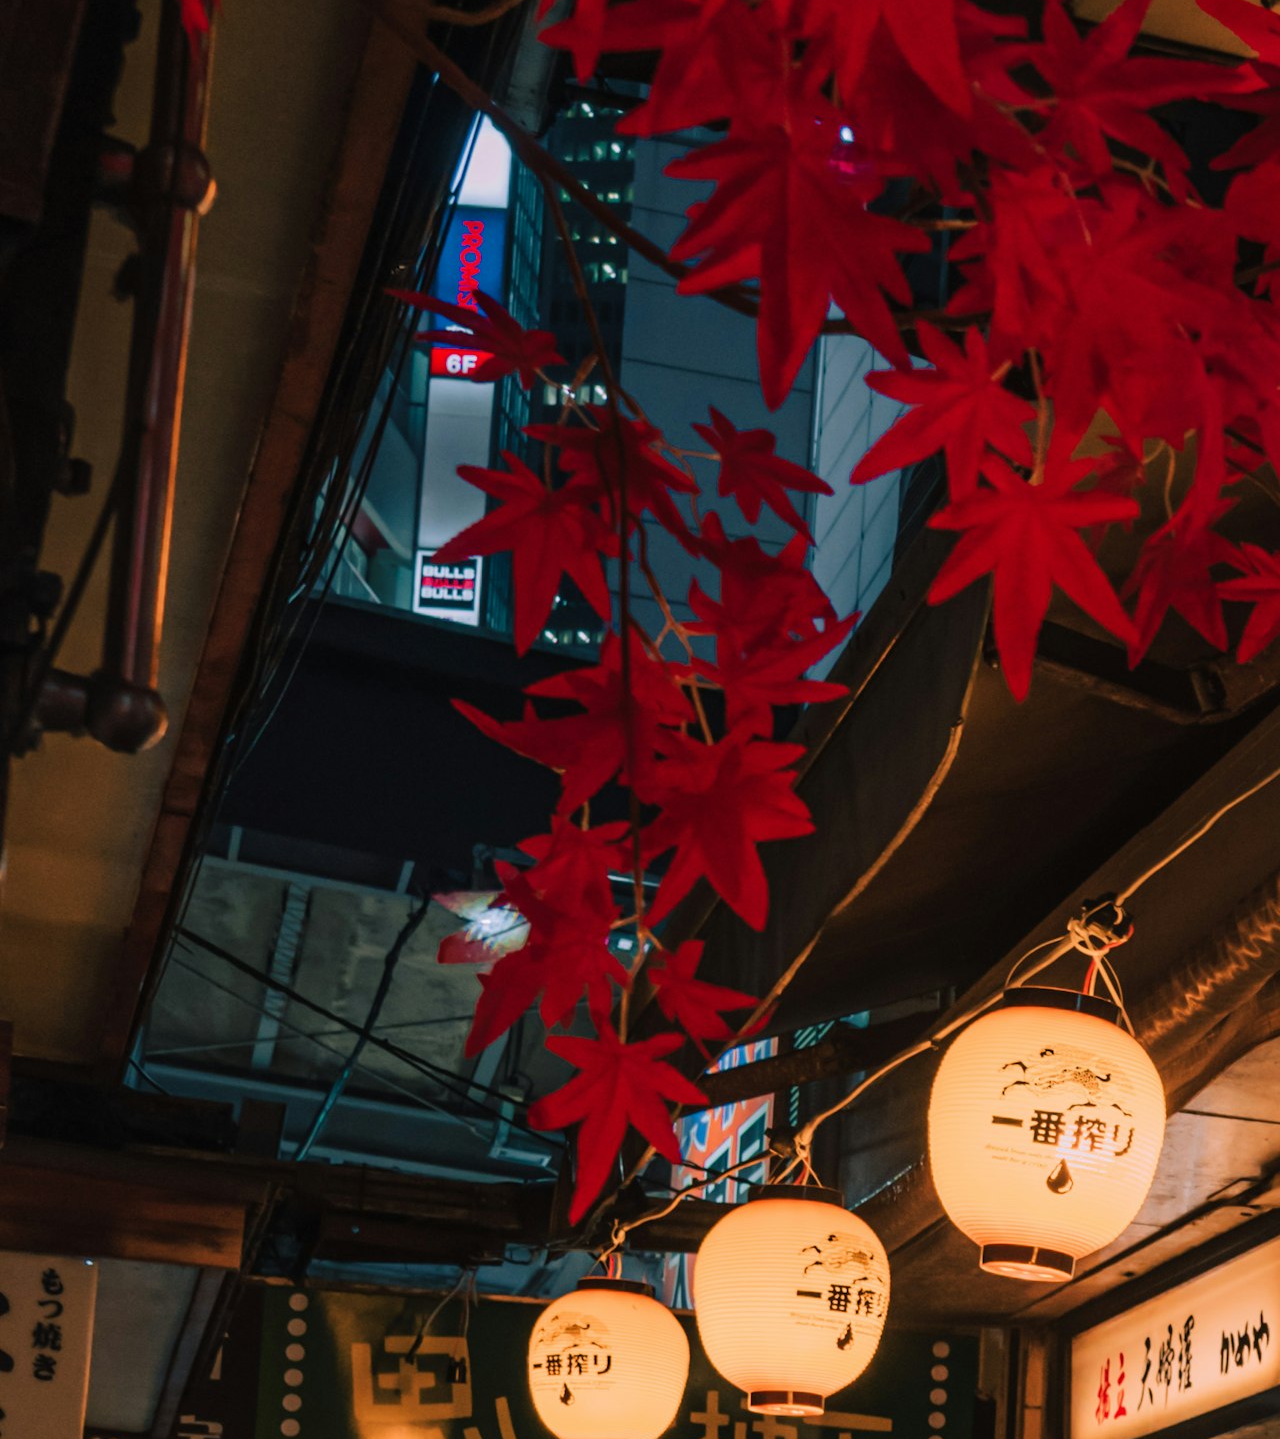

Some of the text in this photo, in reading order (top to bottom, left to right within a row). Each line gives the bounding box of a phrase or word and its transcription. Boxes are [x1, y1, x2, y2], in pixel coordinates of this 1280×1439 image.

[446, 354, 478, 374] 6F
[423, 565, 475, 579] BULLS
[421, 586, 474, 602] BULLS
[991, 1109, 1136, 1157] 一番搾り
[32, 1267, 65, 1382] もつ焼き
[533, 1353, 612, 1376] 一番搾り
[1094, 1309, 1271, 1428] 揚立 天婦羅 かめや
